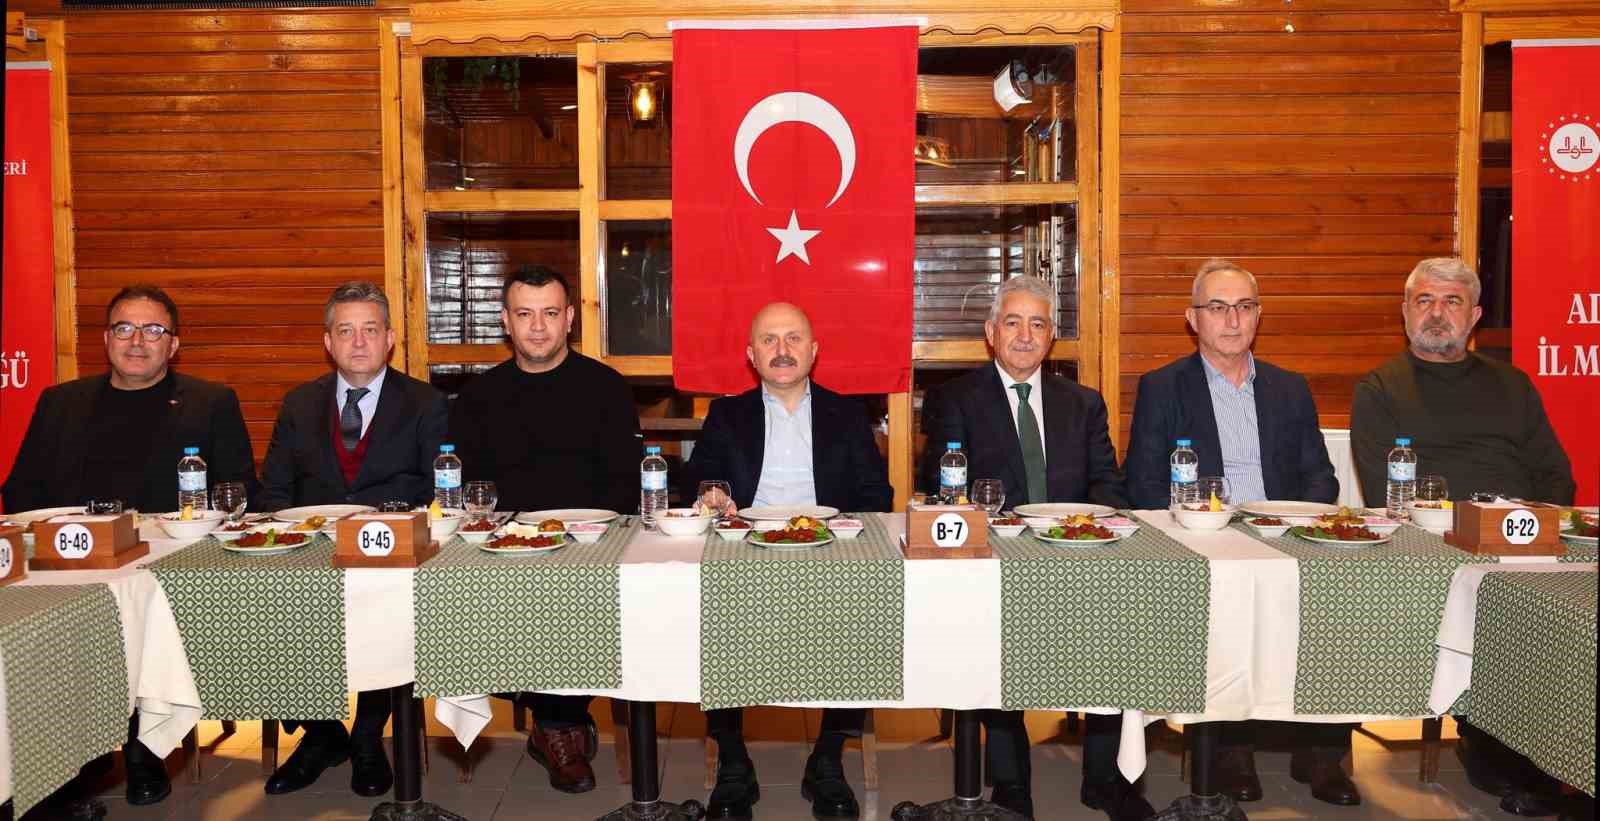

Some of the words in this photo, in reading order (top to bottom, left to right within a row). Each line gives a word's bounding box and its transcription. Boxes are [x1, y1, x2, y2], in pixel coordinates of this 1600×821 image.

[1537, 336, 1568, 376] İL
[936, 521, 963, 541] B-7
[1506, 518, 1535, 537] B-22
[59, 532, 89, 551] B-48
[362, 530, 391, 549] B-45
